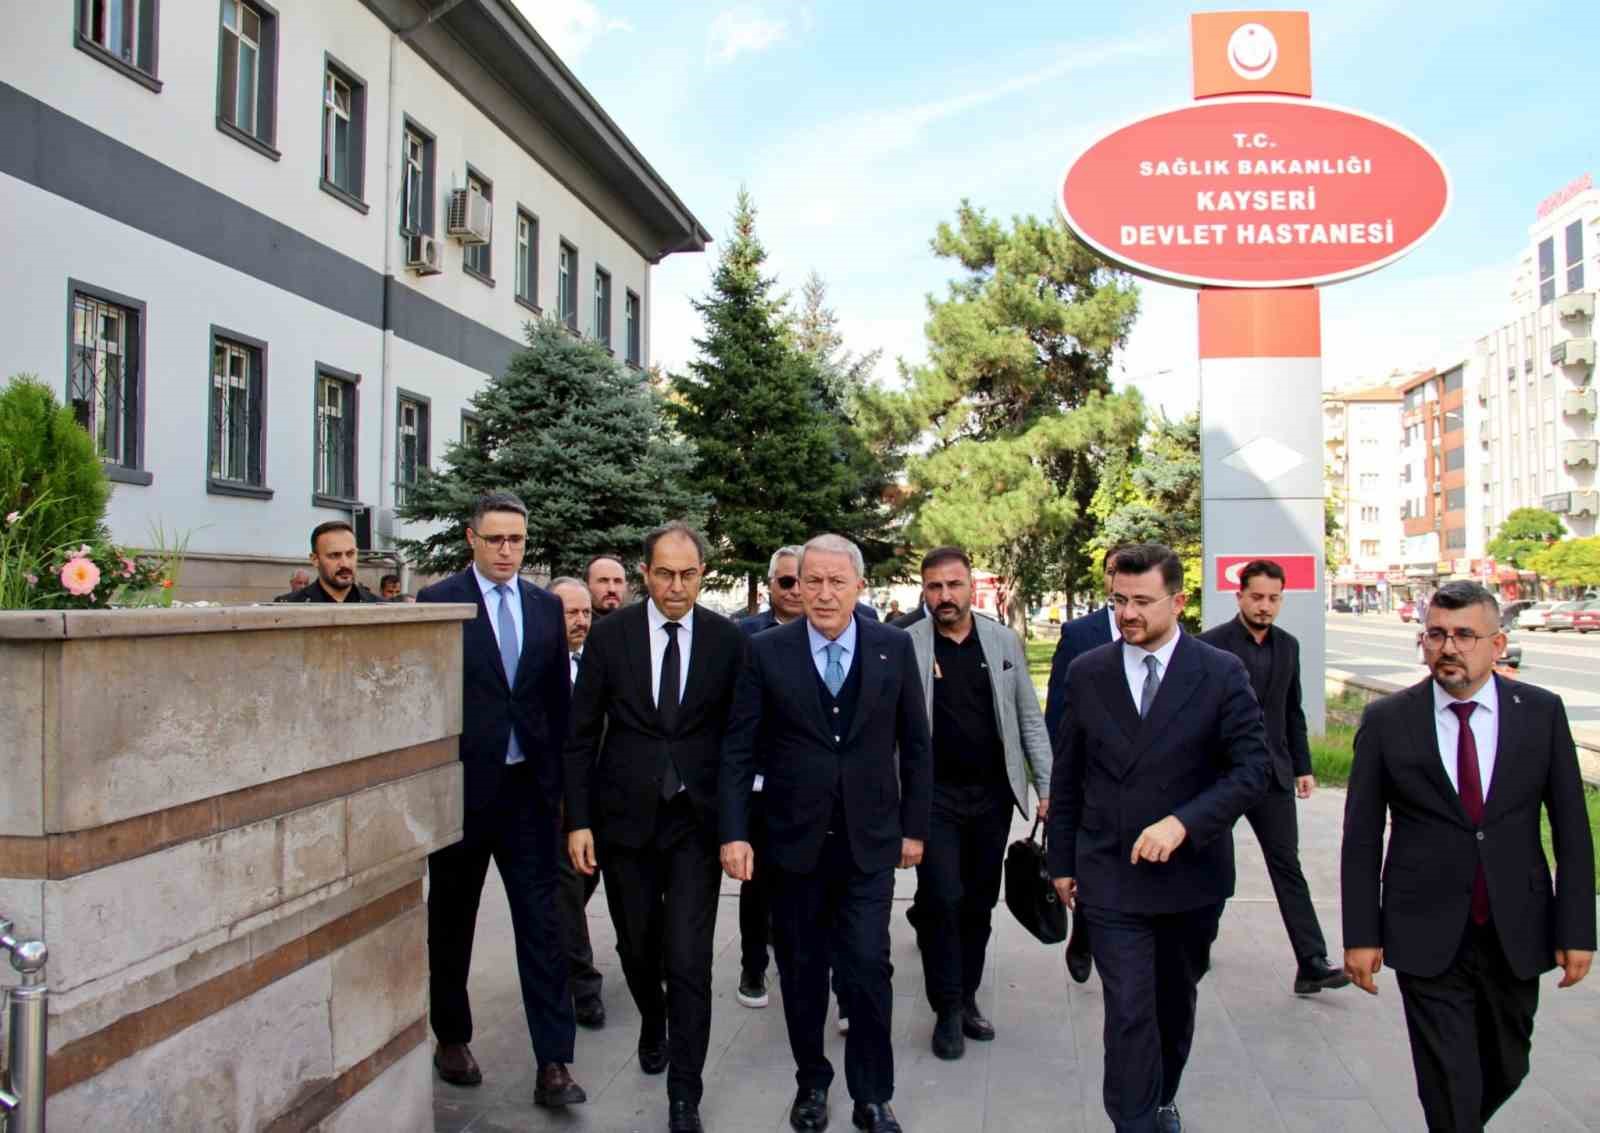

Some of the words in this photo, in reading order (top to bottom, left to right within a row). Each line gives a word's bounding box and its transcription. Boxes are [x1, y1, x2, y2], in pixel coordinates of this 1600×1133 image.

[1233, 133, 1278, 147] T.C.
[1139, 157, 1230, 176] SAĞLIK
[1238, 155, 1371, 175] BAKANLIĞI
[1196, 185, 1316, 211] KAYSERİ
[1120, 224, 1228, 246] DEVLET
[1236, 218, 1394, 244] HASTANESİ
